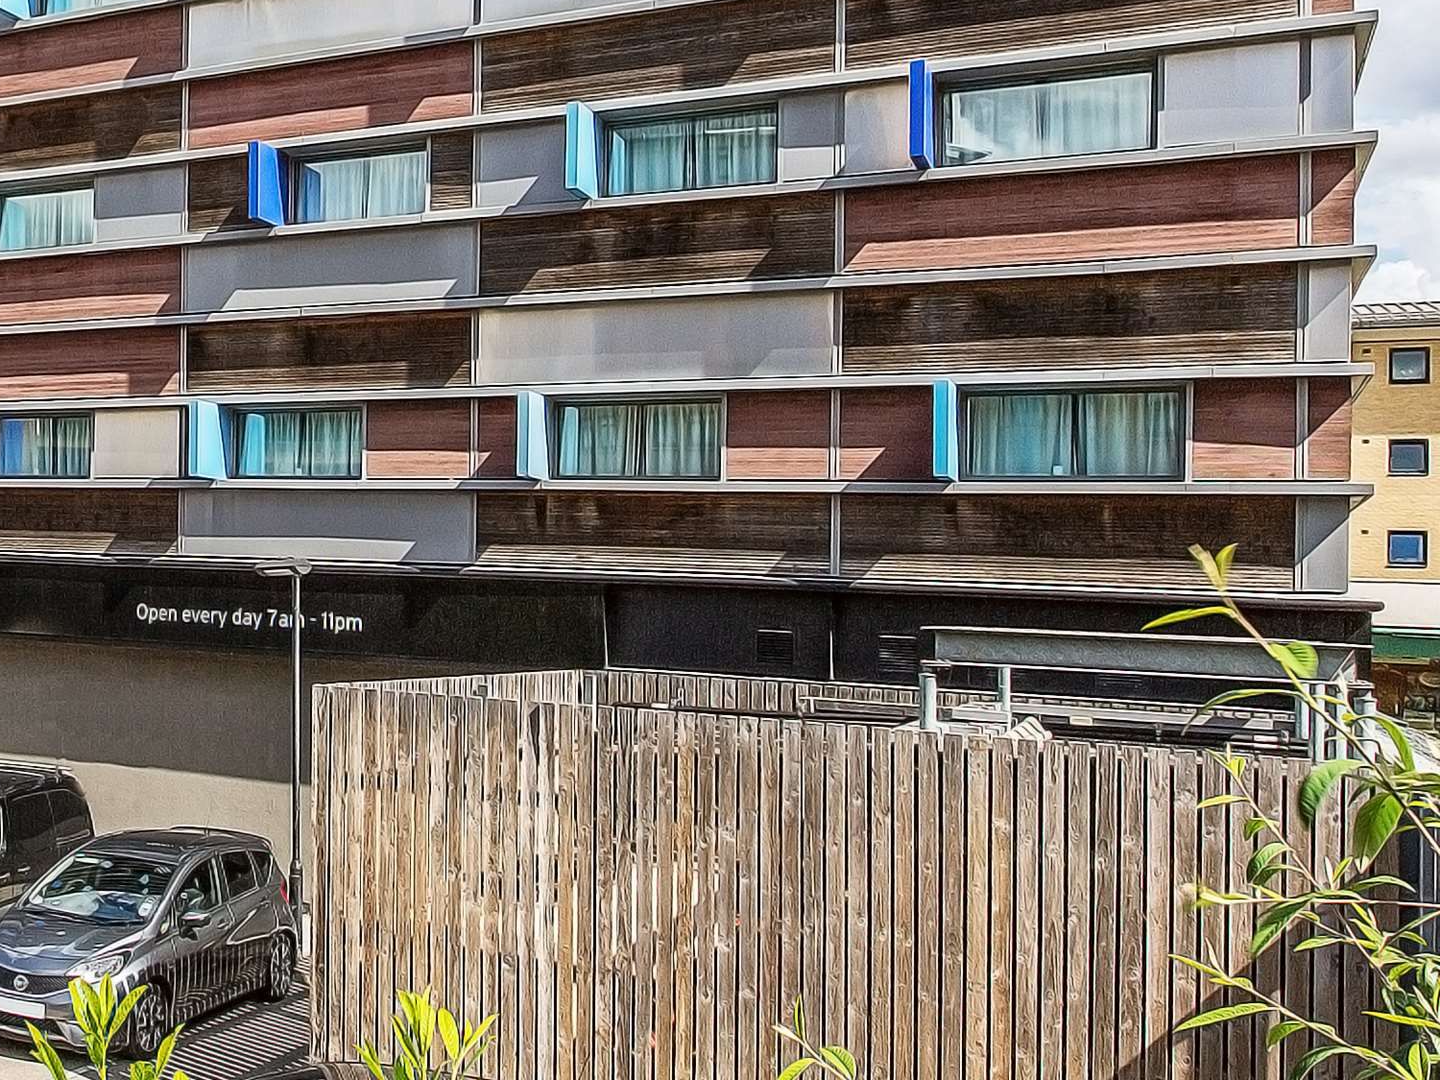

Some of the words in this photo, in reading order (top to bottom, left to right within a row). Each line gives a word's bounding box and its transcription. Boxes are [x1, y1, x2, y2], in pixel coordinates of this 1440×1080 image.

[136, 602, 177, 624] Open
[182, 608, 227, 628] every
[232, 607, 262, 630] day
[321, 611, 363, 634] 11pm
